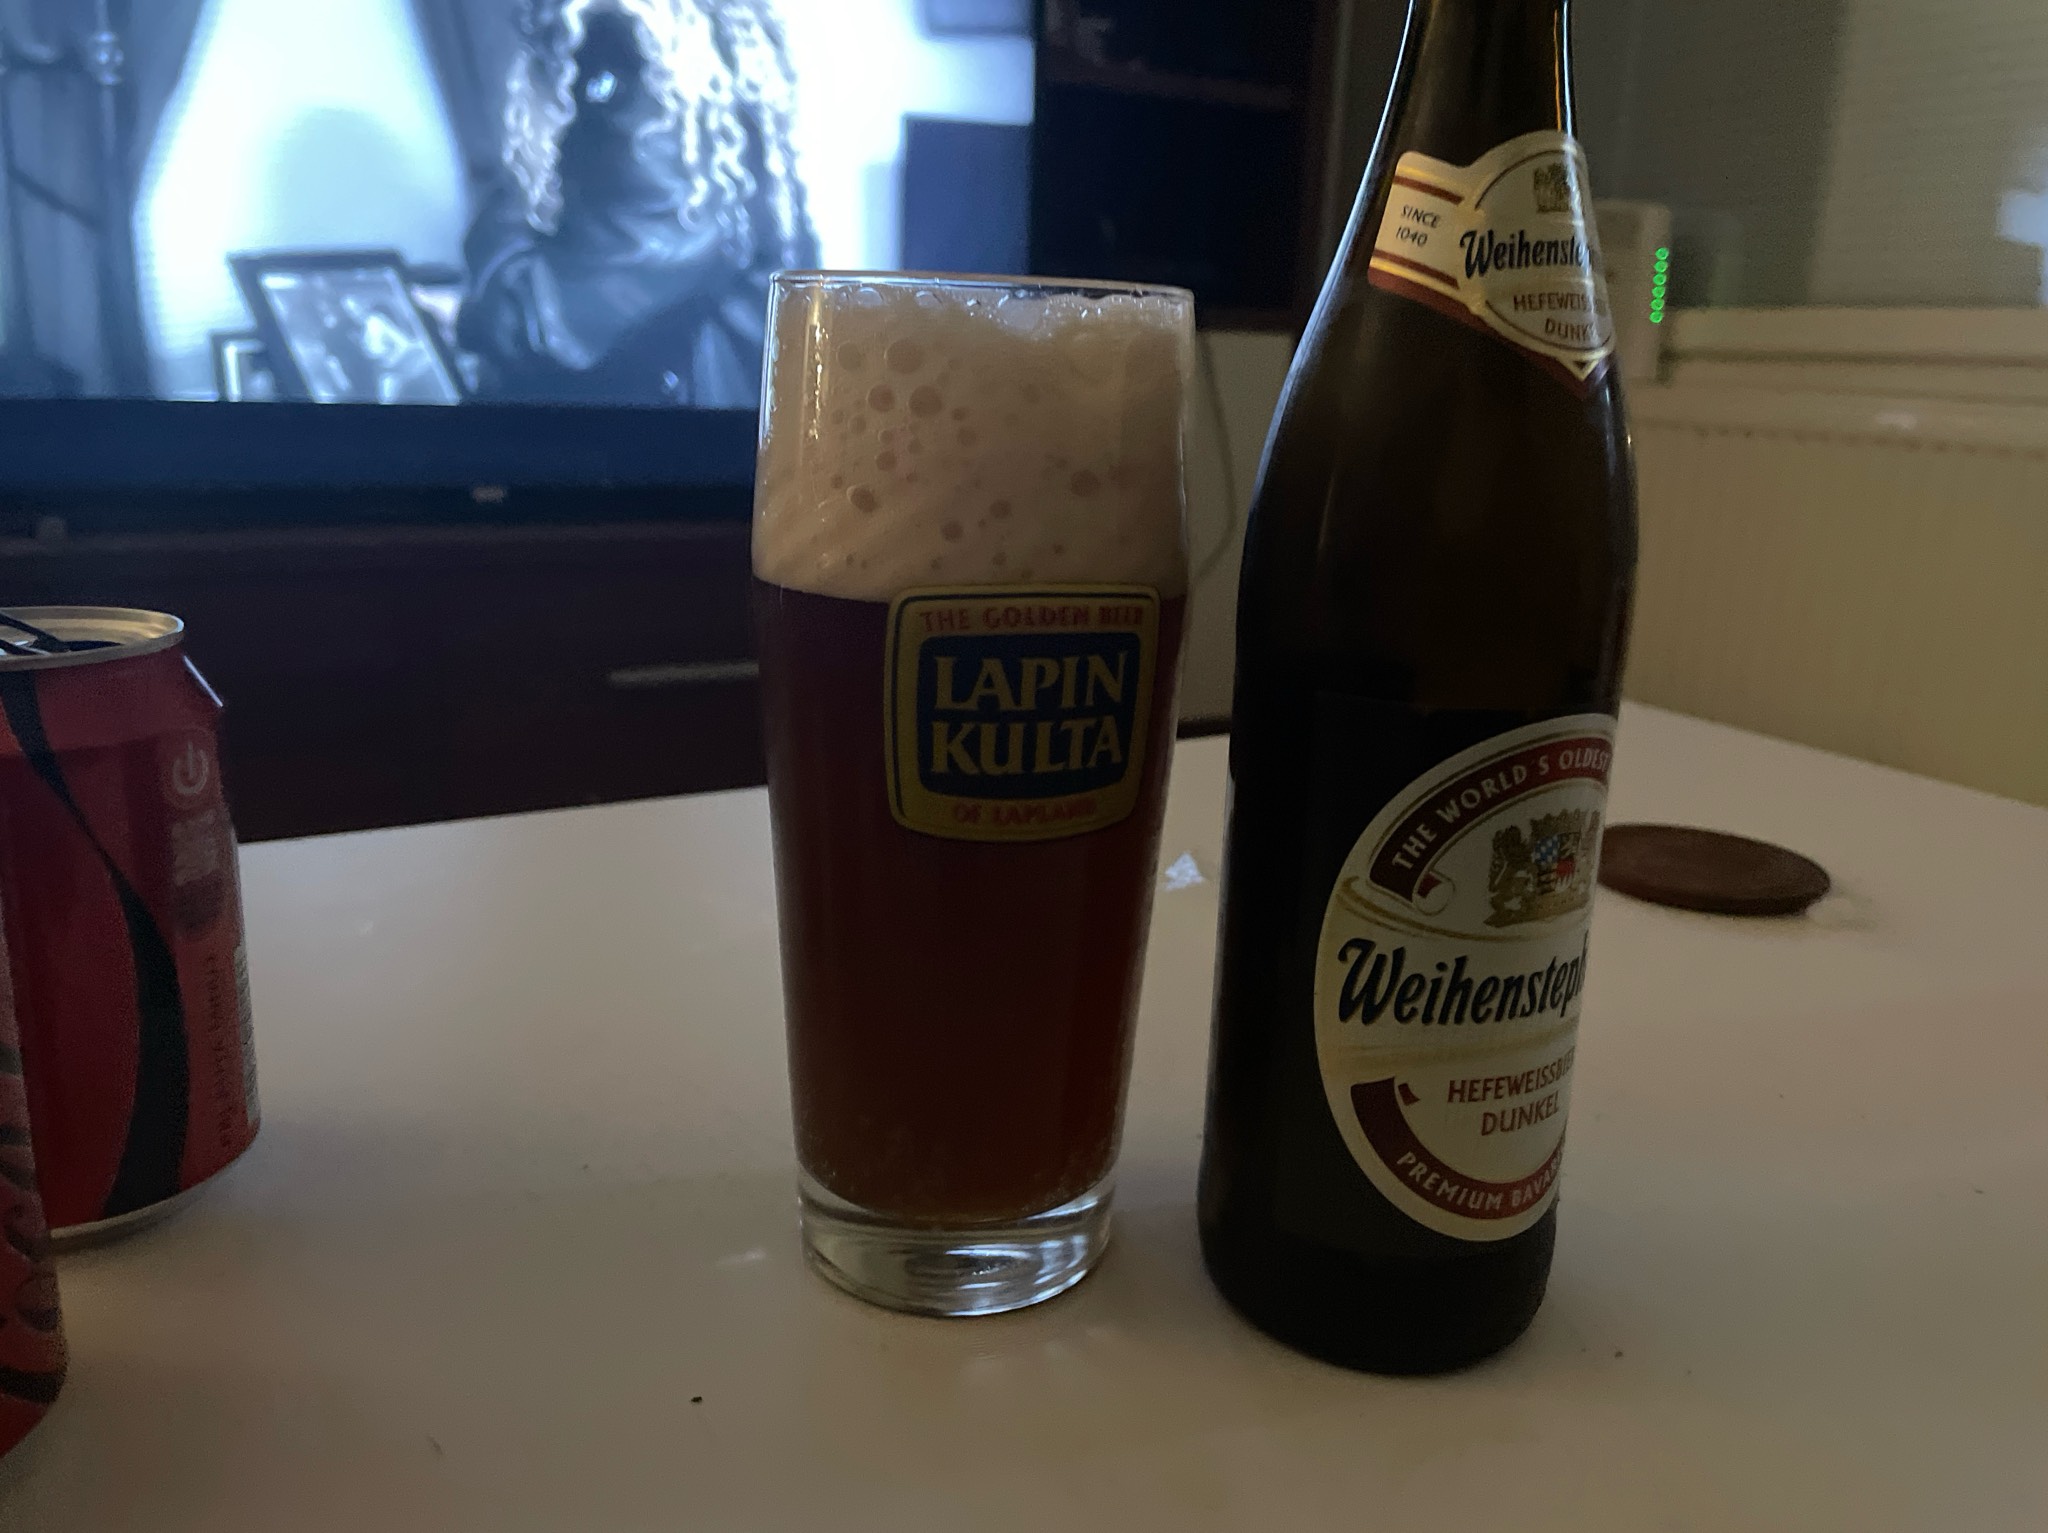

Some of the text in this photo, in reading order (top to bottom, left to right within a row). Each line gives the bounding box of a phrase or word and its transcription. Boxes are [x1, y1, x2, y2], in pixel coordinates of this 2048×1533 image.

[1395, 226, 1428, 247] 1040
[1401, 204, 1440, 228] SINCE
[919, 607, 970, 632] THE
[982, 605, 1090, 630] GOLDEN
[935, 652, 1128, 711] LAPIN
[930, 714, 1123, 777] KULTA
[1391, 823, 1437, 870] THE
[1482, 1090, 1559, 1136] DUNKEL
[1396, 1150, 1504, 1211] PREMIUM
